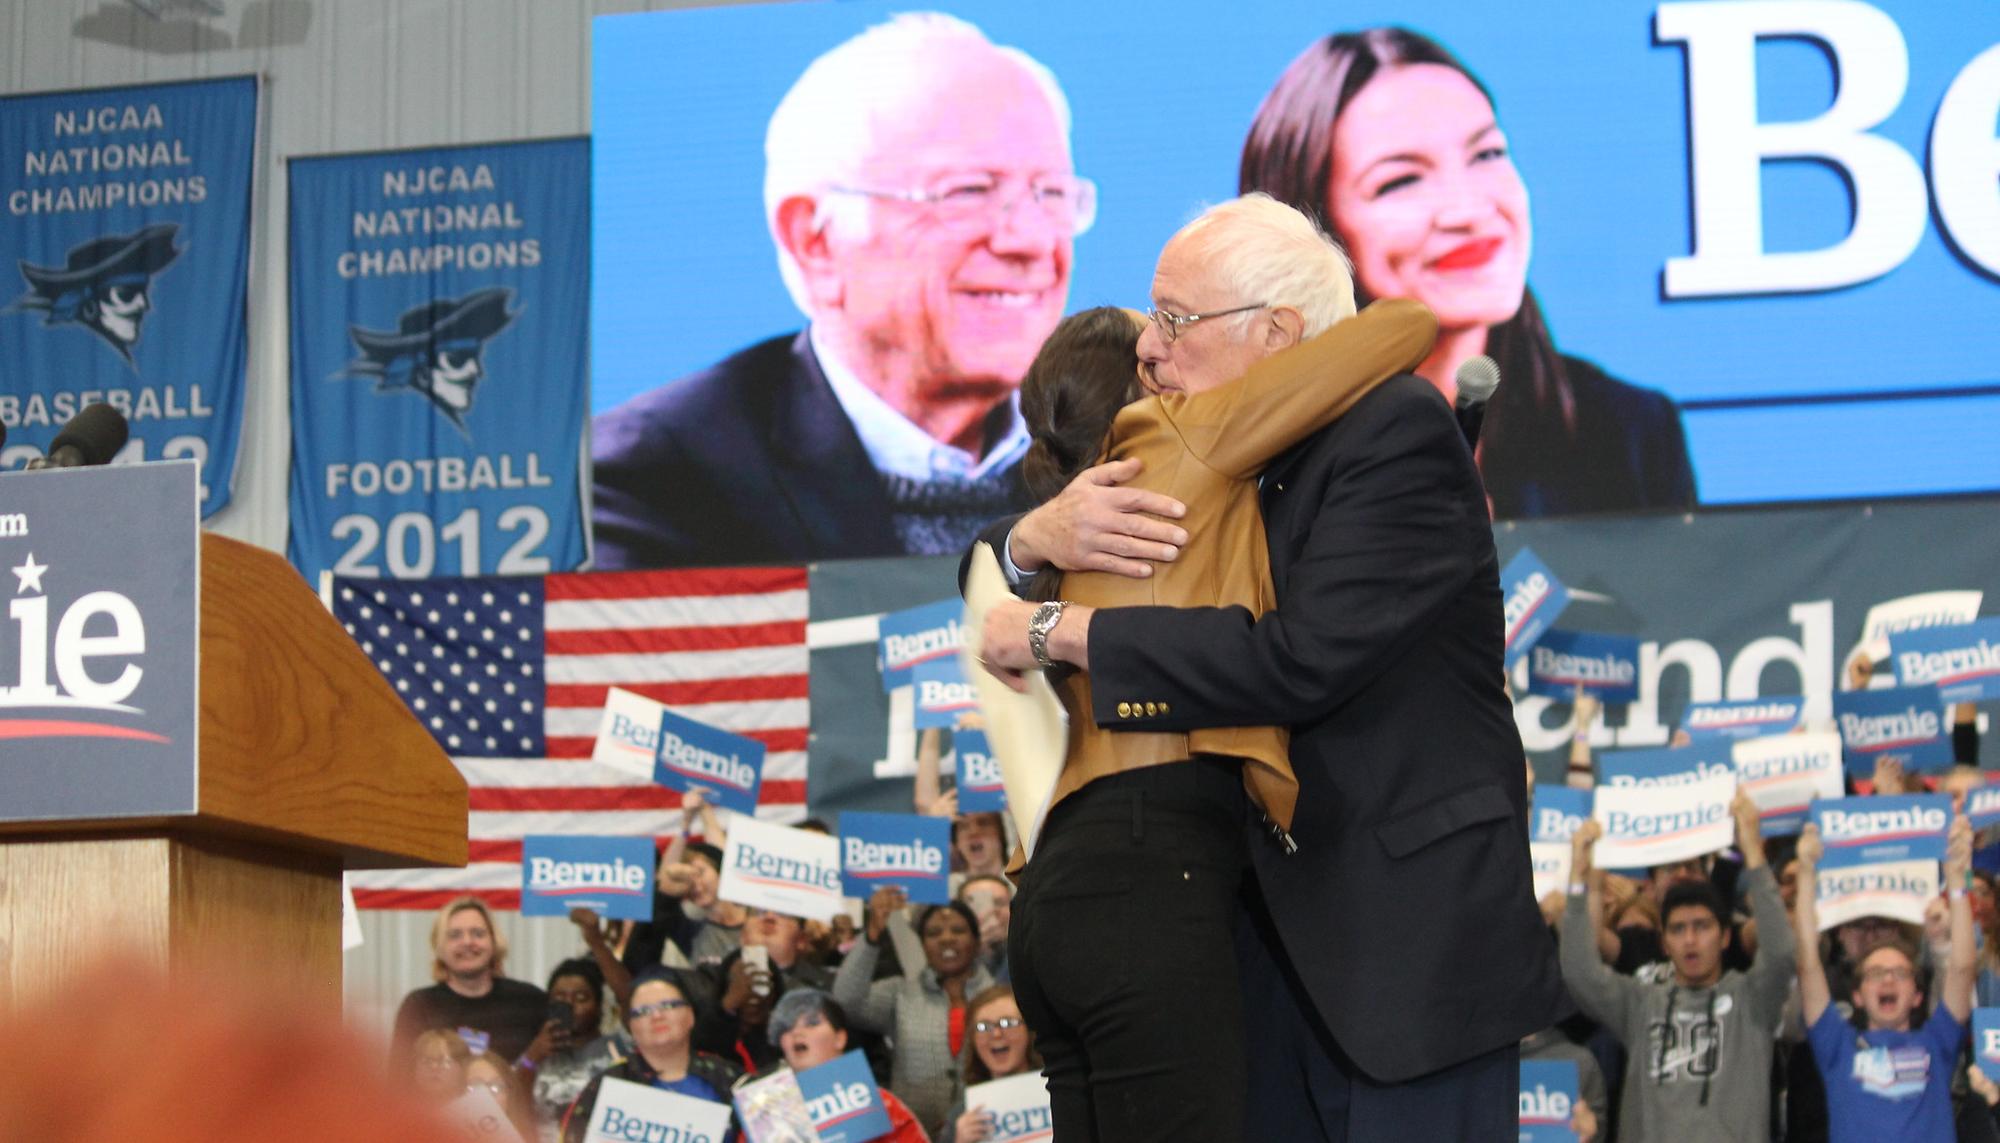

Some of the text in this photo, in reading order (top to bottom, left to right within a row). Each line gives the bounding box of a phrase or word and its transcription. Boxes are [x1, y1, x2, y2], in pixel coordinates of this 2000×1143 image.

[55, 104, 164, 136] NJCAA
[24, 140, 192, 176] NATIONAL
[9, 175, 207, 216] CHAMPIONS
[384, 165, 495, 196] NJCAA
[354, 202, 523, 238] NATIONAL
[338, 240, 542, 279] CHAMPIONS
[326, 454, 551, 497] FOOTBALL
[331, 506, 550, 578] 2012
[1534, 645, 1635, 682] Bernie
[1842, 708, 1939, 750] Bernie
[661, 728, 755, 789] Bernie
[1735, 751, 1831, 782] ernie
[1606, 802, 1724, 838] Bernie
[1819, 804, 1946, 841] Bernie
[734, 843, 841, 892] Bernie
[844, 836, 942, 873] Bernie
[530, 857, 646, 891] Bernie
